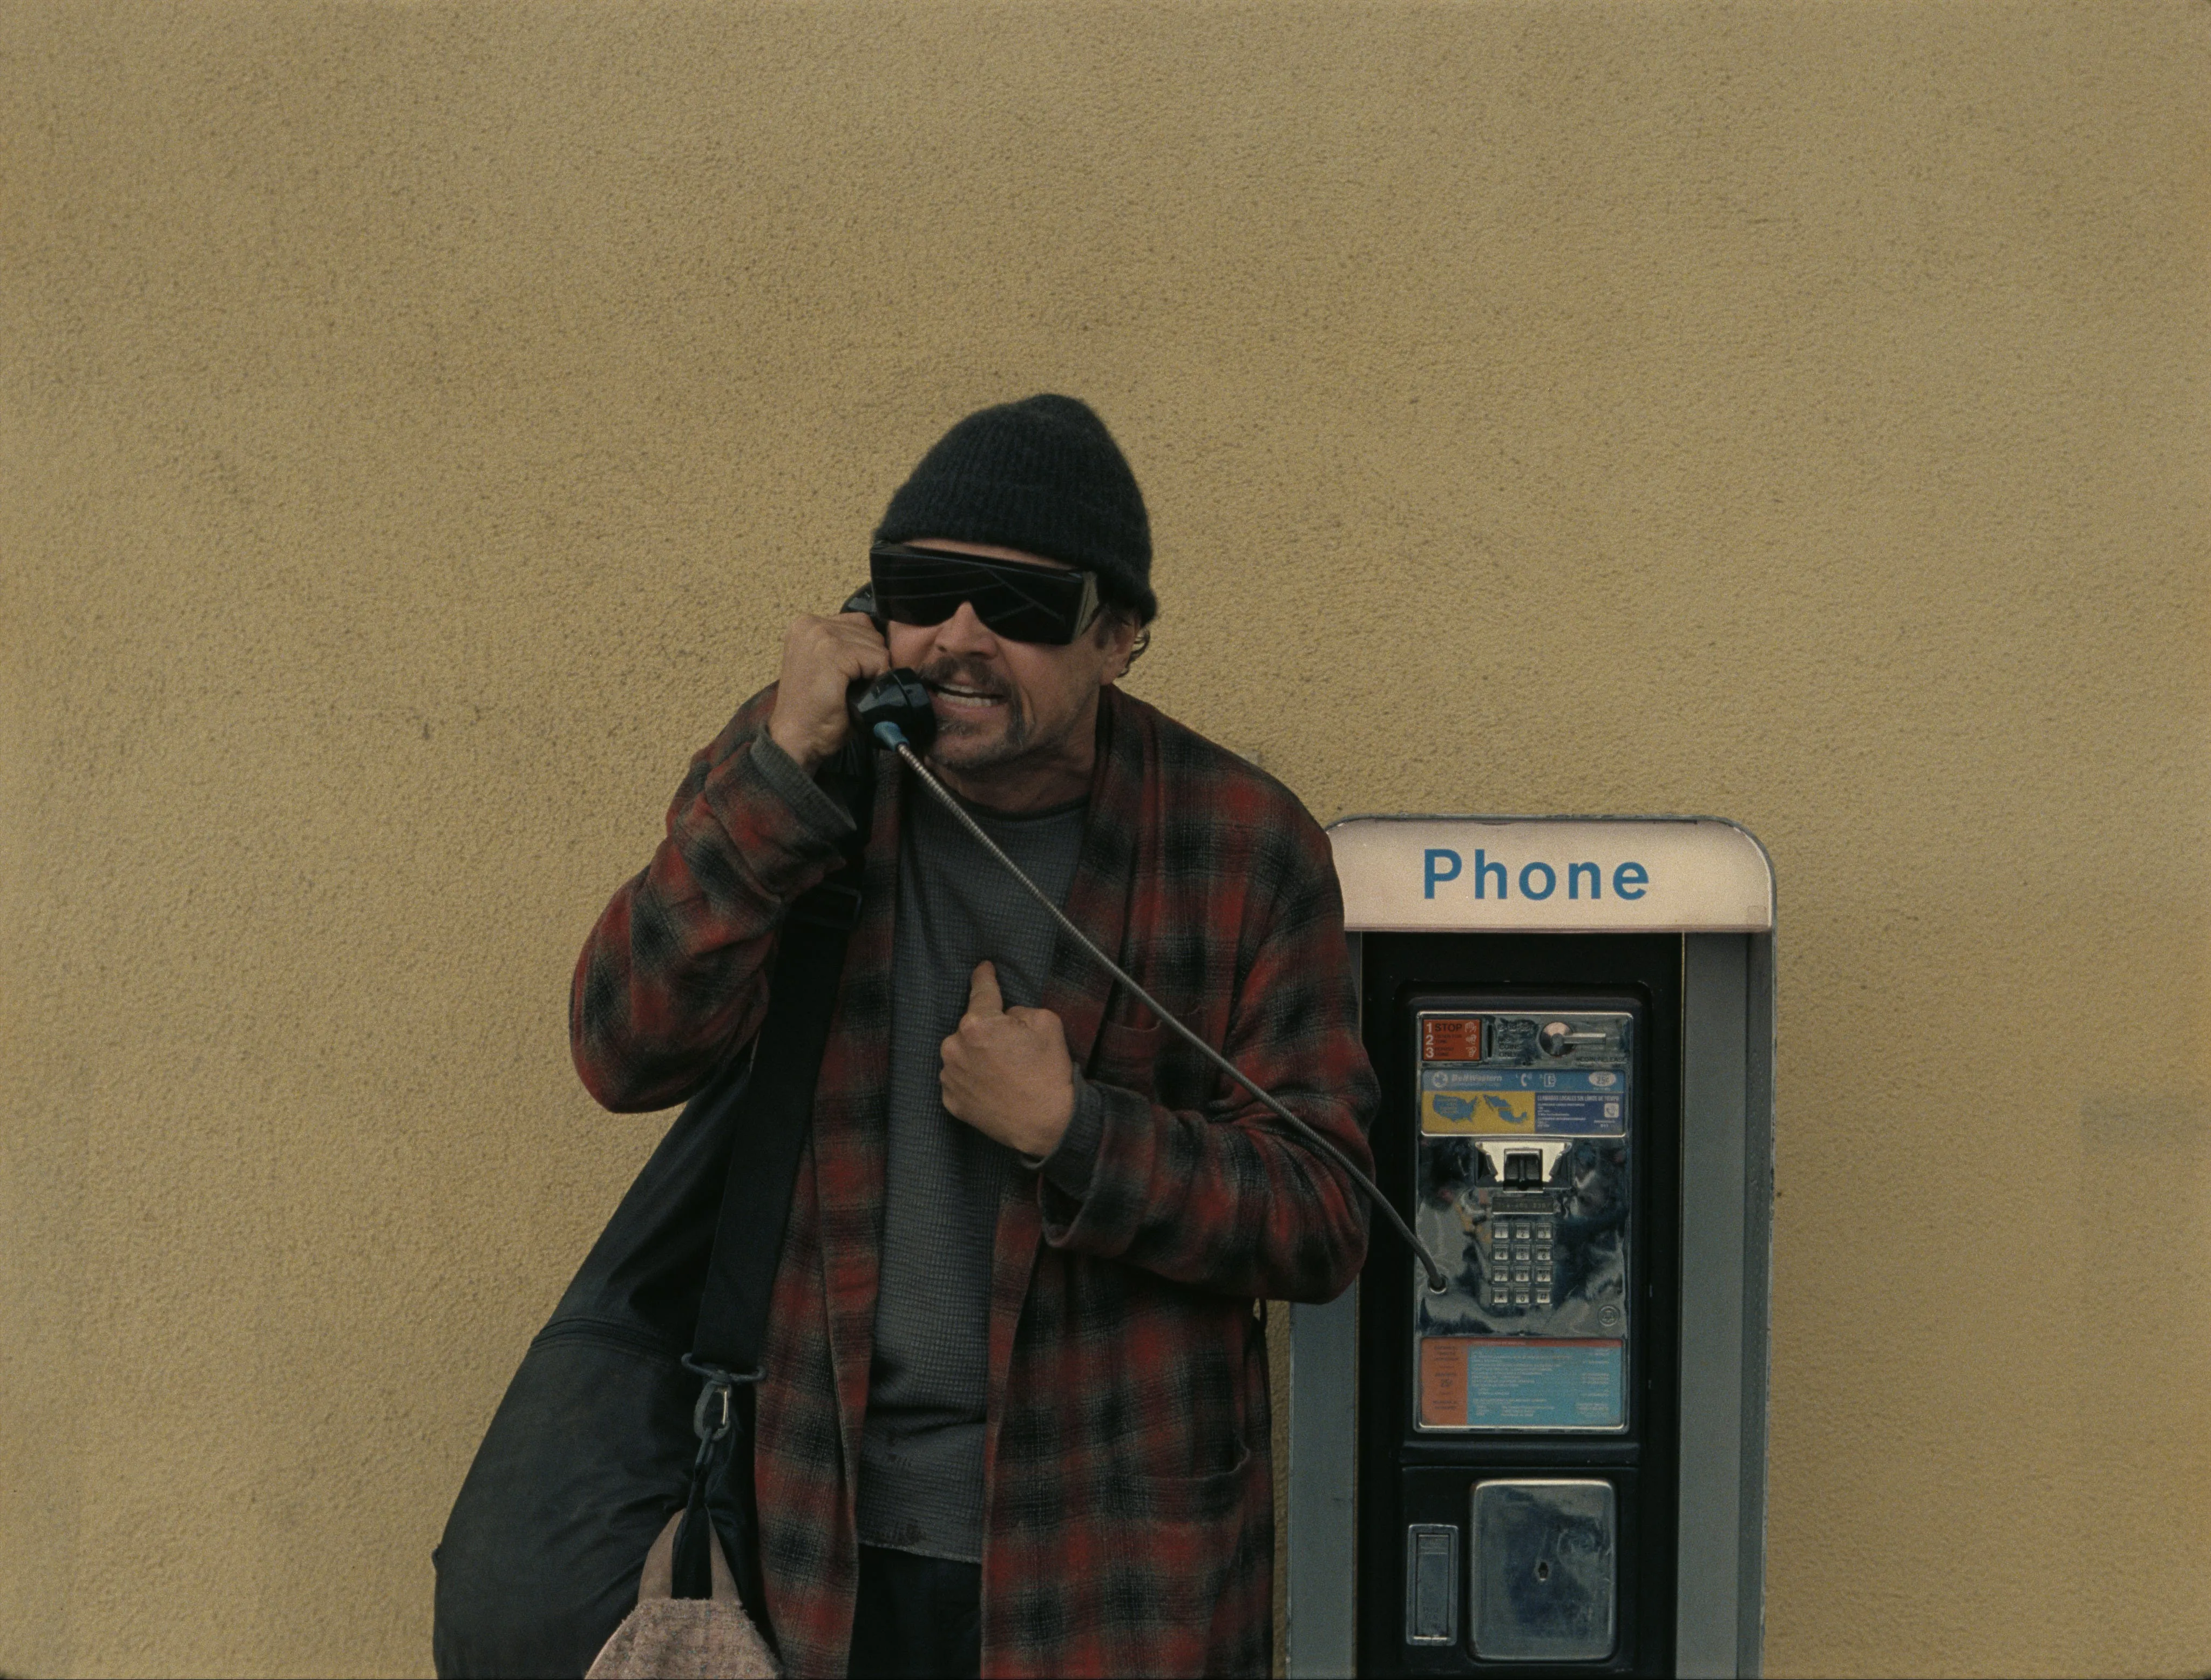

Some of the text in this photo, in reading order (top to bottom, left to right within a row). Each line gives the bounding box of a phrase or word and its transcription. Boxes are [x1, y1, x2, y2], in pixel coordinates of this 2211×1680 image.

[1424, 848, 1649, 900] Phone
[1426, 1022, 1462, 1033] 1 STOP
[1426, 1034, 1434, 1045] 2
[1426, 1047, 1434, 1058] 3
